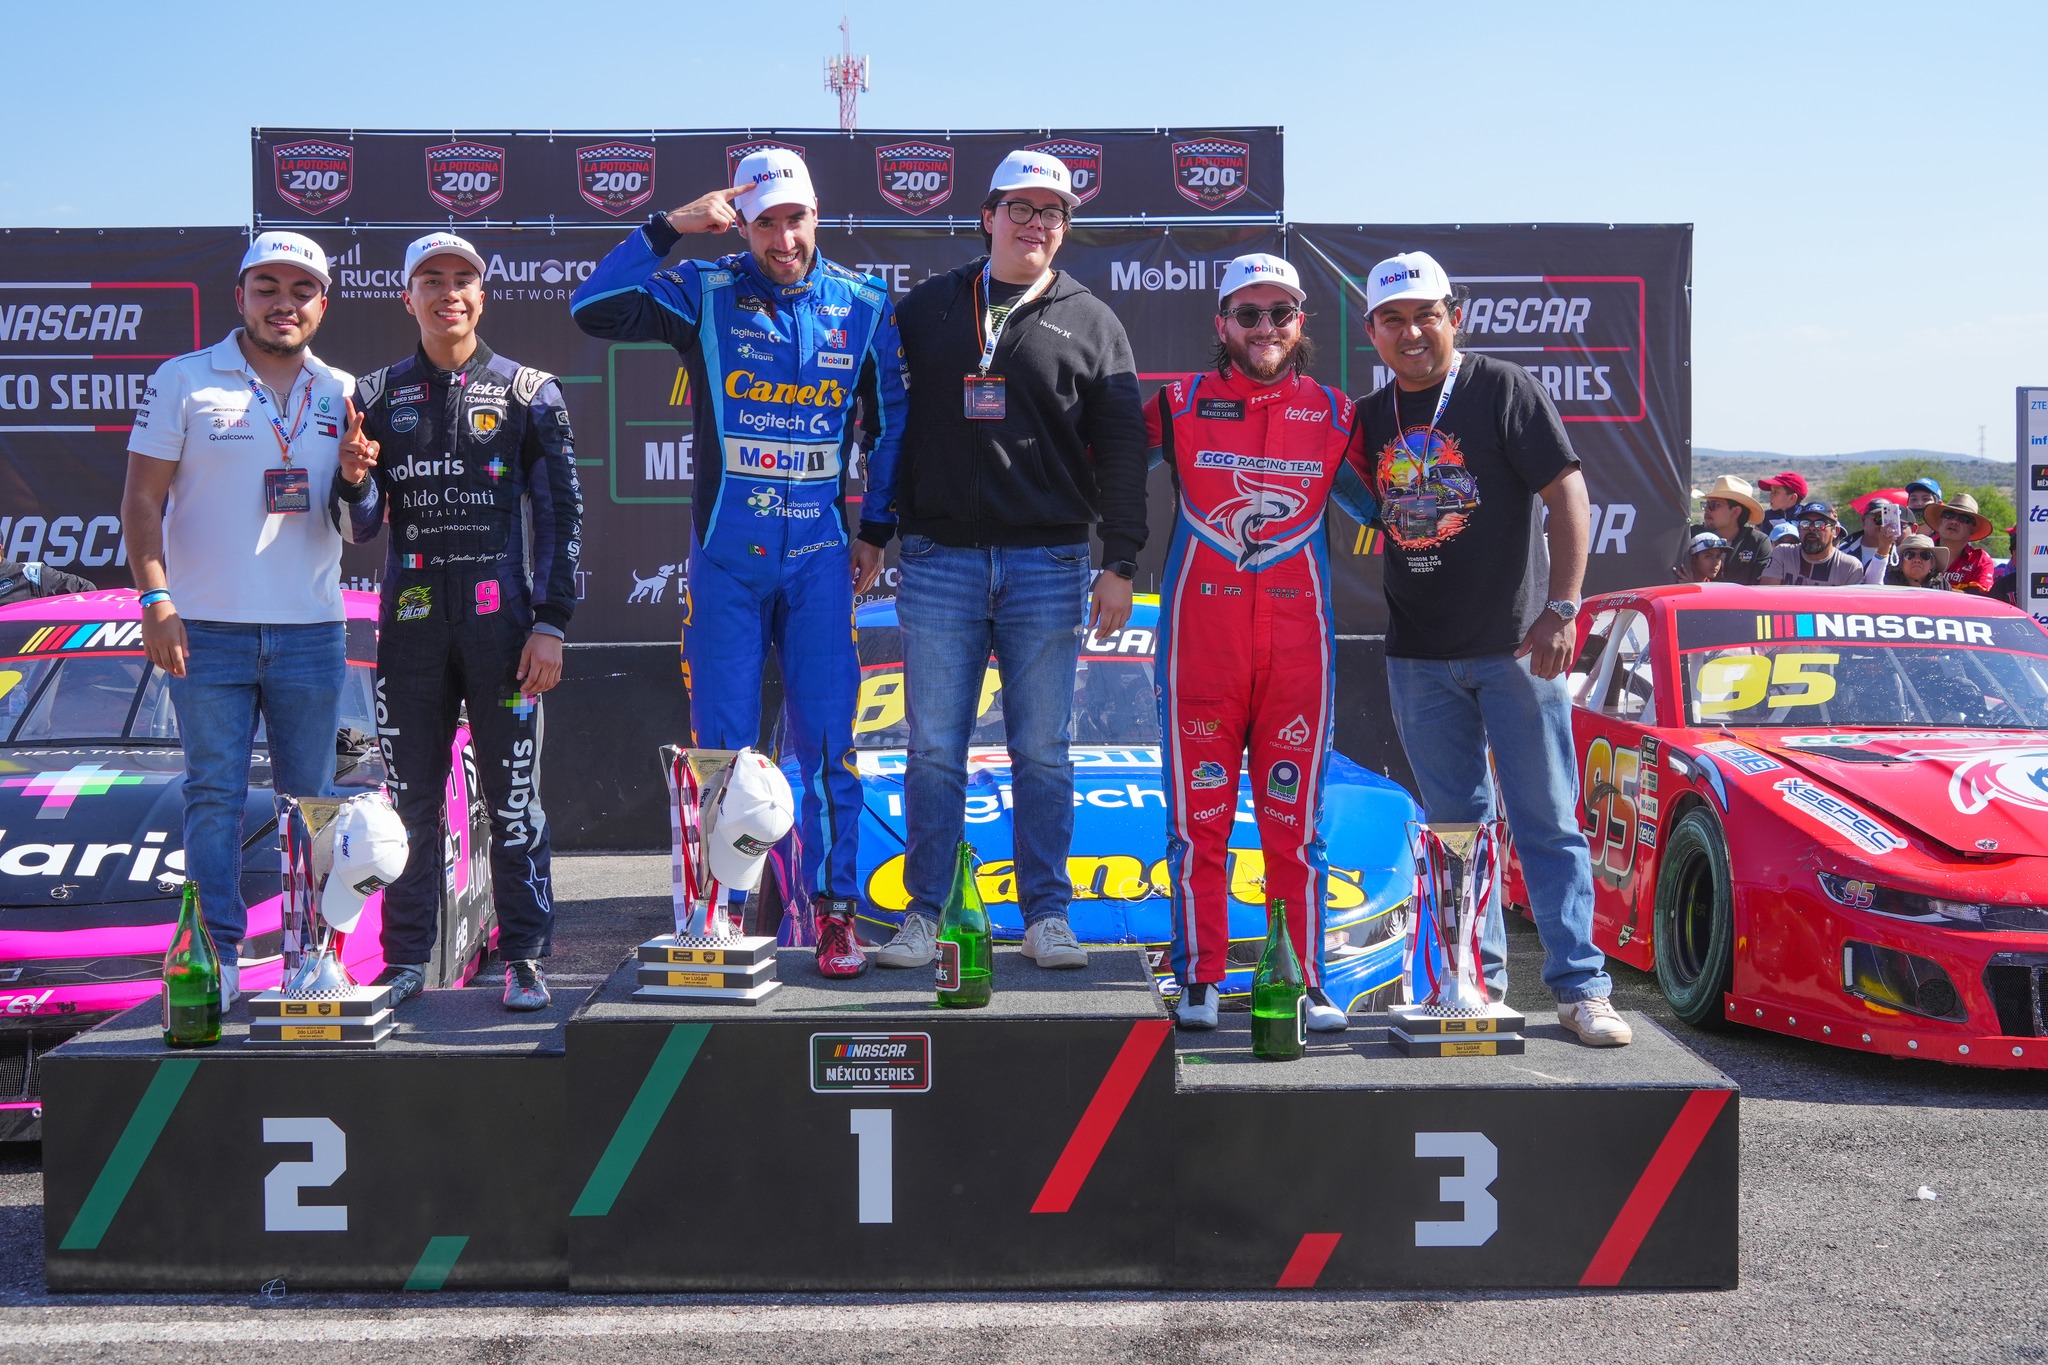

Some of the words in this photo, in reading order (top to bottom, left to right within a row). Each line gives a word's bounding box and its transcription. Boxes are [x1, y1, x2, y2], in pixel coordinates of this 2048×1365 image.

[281, 160, 294, 170] LA
[296, 160, 347, 171] POTOSINA
[433, 161, 446, 172] LA
[448, 161, 499, 172] POTOSINA
[584, 161, 598, 172] LA
[600, 161, 649, 172] POTOSINA
[883, 161, 897, 172] LA
[899, 161, 949, 172] POTOSINA
[1022, 165, 1052, 177] Mobil
[1180, 158, 1193, 168] LA
[1195, 157, 1243, 168] POTOSINA
[289, 170, 340, 190] 200
[441, 172, 491, 191] 200
[592, 172, 642, 191] 200
[752, 169, 782, 184] Mobil
[892, 172, 941, 191] 200
[1188, 168, 1236, 186] 200
[272, 242, 302, 255] Mobil
[422, 239, 452, 251] Mobil
[1111, 261, 1205, 291] Mobil
[1245, 264, 1274, 275] Mobil
[341, 270, 405, 287] RUCK
[708, 274, 730, 284] OMP
[1380, 270, 1408, 287] Mobil
[815, 303, 852, 317] telcel
[731, 326, 766, 339] logitech
[1040, 319, 1063, 335] Hurley
[751, 353, 774, 362] TEQUIS
[821, 356, 842, 364] Mobil
[51, 374, 145, 410] SERIE
[248, 379, 263, 398] Mobil
[467, 380, 511, 396] telcel
[725, 369, 848, 408] Canel's
[1285, 406, 1328, 422] telcel
[2031, 401, 2048, 410] ZTE
[228, 419, 250, 428] UBS
[272, 417, 287, 438] Mobil
[739, 410, 805, 431] logitech
[209, 433, 254, 441] Qualcomm
[387, 452, 465, 482] volaris
[740, 446, 805, 472] Mobil
[808, 452, 825, 471] 1
[1202, 452, 1235, 465] GGG
[1237, 456, 1287, 471] RACING
[1289, 461, 1322, 473] TEAM
[402, 490, 438, 509] Aldo
[444, 487, 496, 506] Conti
[421, 508, 467, 518] ITALIA
[421, 524, 490, 534] HEALTHADDICTION
[475, 580, 501, 615] 9
[399, 605, 432, 619] FALCON
[1816, 613, 1995, 646] NASCAR
[1696, 653, 1840, 715] 95
[1583, 737, 1639, 877] 95
[1641, 800, 1653, 812] Mobil
[1787, 796, 1830, 820] OILFIELD
[1640, 824, 1656, 845] telcel
[342, 835, 350, 858] telcel
[1843, 880, 1876, 908] 95
[852, 1044, 907, 1057] NASCAR
[826, 1064, 871, 1081] MÉXICO
[874, 1067, 915, 1081] SERIES
[262, 1117, 348, 1232] 2
[850, 1109, 893, 1224] 1
[1415, 1131, 1498, 1247] 3
